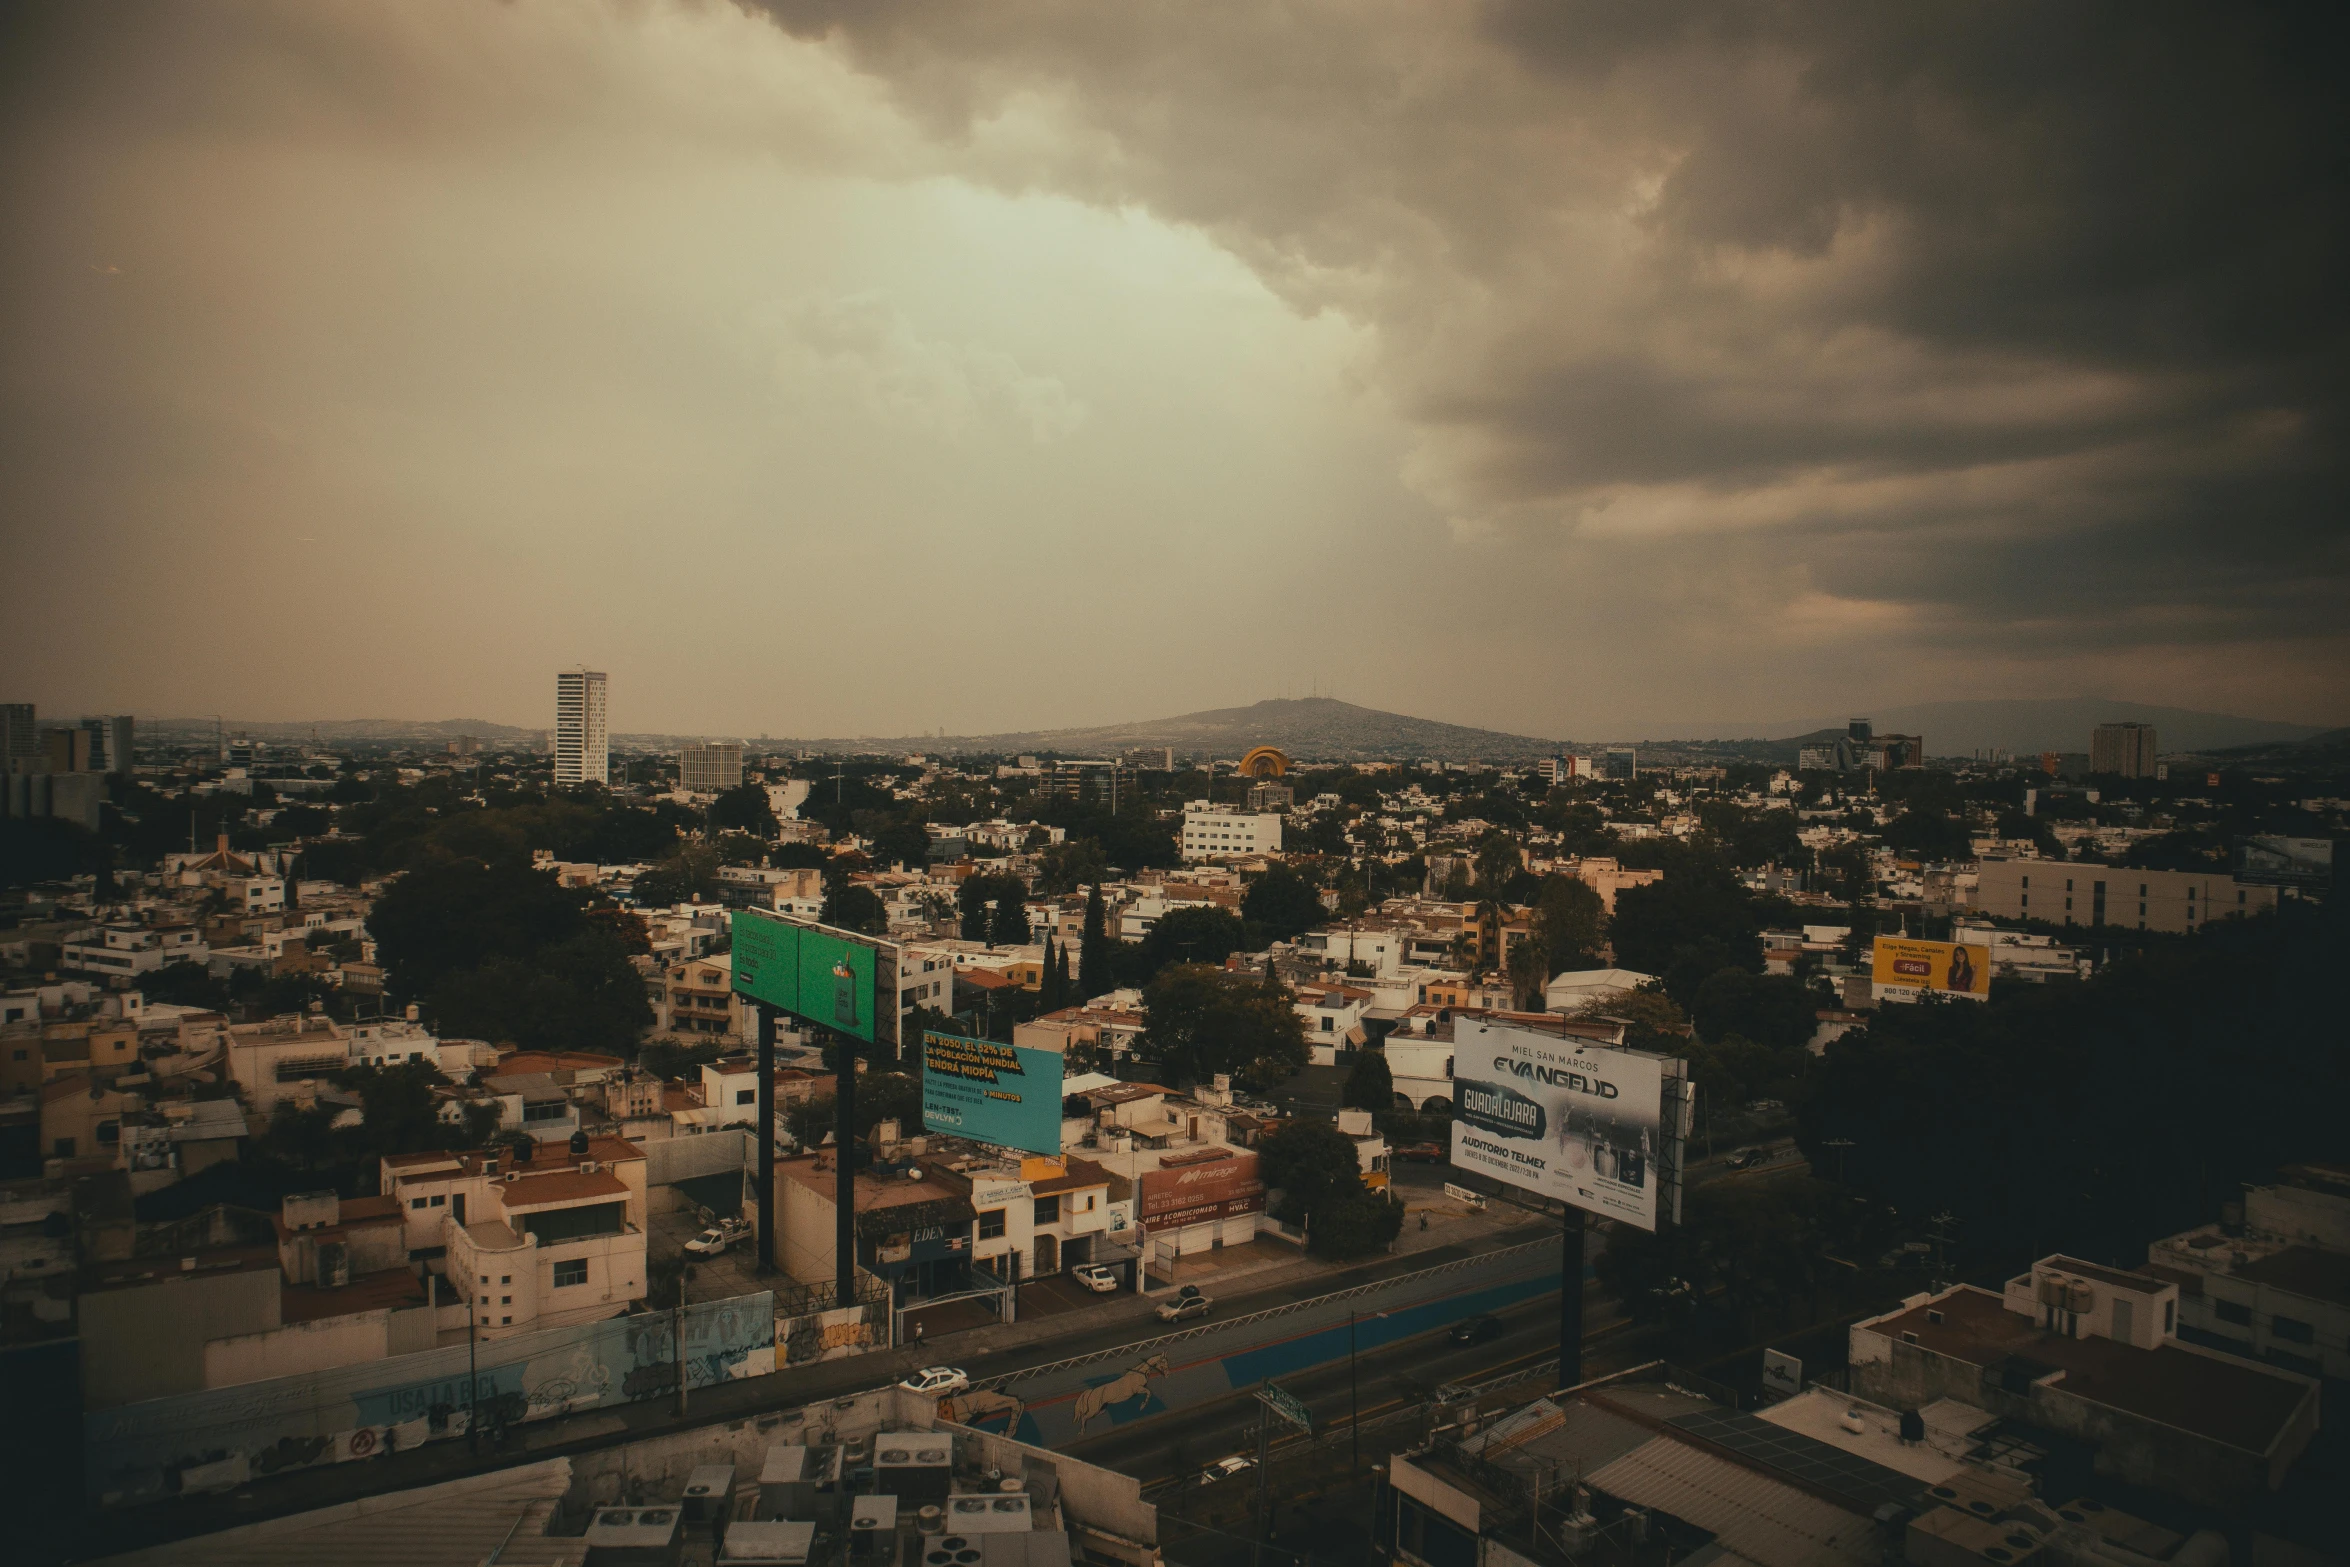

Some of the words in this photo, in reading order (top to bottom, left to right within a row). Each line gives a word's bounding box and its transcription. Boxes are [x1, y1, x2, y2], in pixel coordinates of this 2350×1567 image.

[1882, 943, 1897, 951] Elige
[1899, 945, 1920, 953] Megas,
[1921, 946, 1945, 955] Canales
[1900, 952, 1931, 960] Streaming
[1884, 987, 1896, 995] 800
[924, 1034, 937, 1044] EN
[938, 1036, 963, 1050] 2050,
[965, 1041, 977, 1052] EL
[979, 1043, 998, 1056] 52%
[1000, 1046, 1013, 1058] DE
[924, 1046, 934, 1056] LA
[936, 1048, 981, 1064] POBLACIÓN
[982, 1056, 1021, 1070] MUNDIAL
[1512, 1045, 1533, 1058] MIEL
[1537, 1051, 1555, 1063] SAN
[1559, 1055, 1599, 1073] MARCOS
[925, 1057, 960, 1073] TENDRÁ
[961, 1064, 995, 1079] MIOPÍA
[983, 1088, 989, 1098] 6
[989, 1090, 1021, 1103] MINUTOS
[1464, 1088, 1537, 1127] GUADALAJARA
[924, 1111, 955, 1124] DEVLYN
[1461, 1135, 1509, 1158] AUDITORIO
[1511, 1150, 1546, 1170] TELMEX
[1464, 1149, 1478, 1160] JUEVES
[1488, 1157, 1509, 1171] DICIEMBRE
[1199, 1166, 1239, 1179] mirage
[1148, 1192, 1173, 1201] AIRETEC
[1148, 1202, 1160, 1210] Tel.
[1161, 1200, 1170, 1209] 33
[1171, 1197, 1186, 1208] 3162
[1145, 1215, 1160, 1224] AIRE
[1163, 1204, 1218, 1221] ACONDICIONADO
[1229, 1203, 1249, 1213] HVAC
[913, 1224, 945, 1243] EDEN
[389, 1388, 425, 1415] USA
[460, 1376, 495, 1402] BCI
